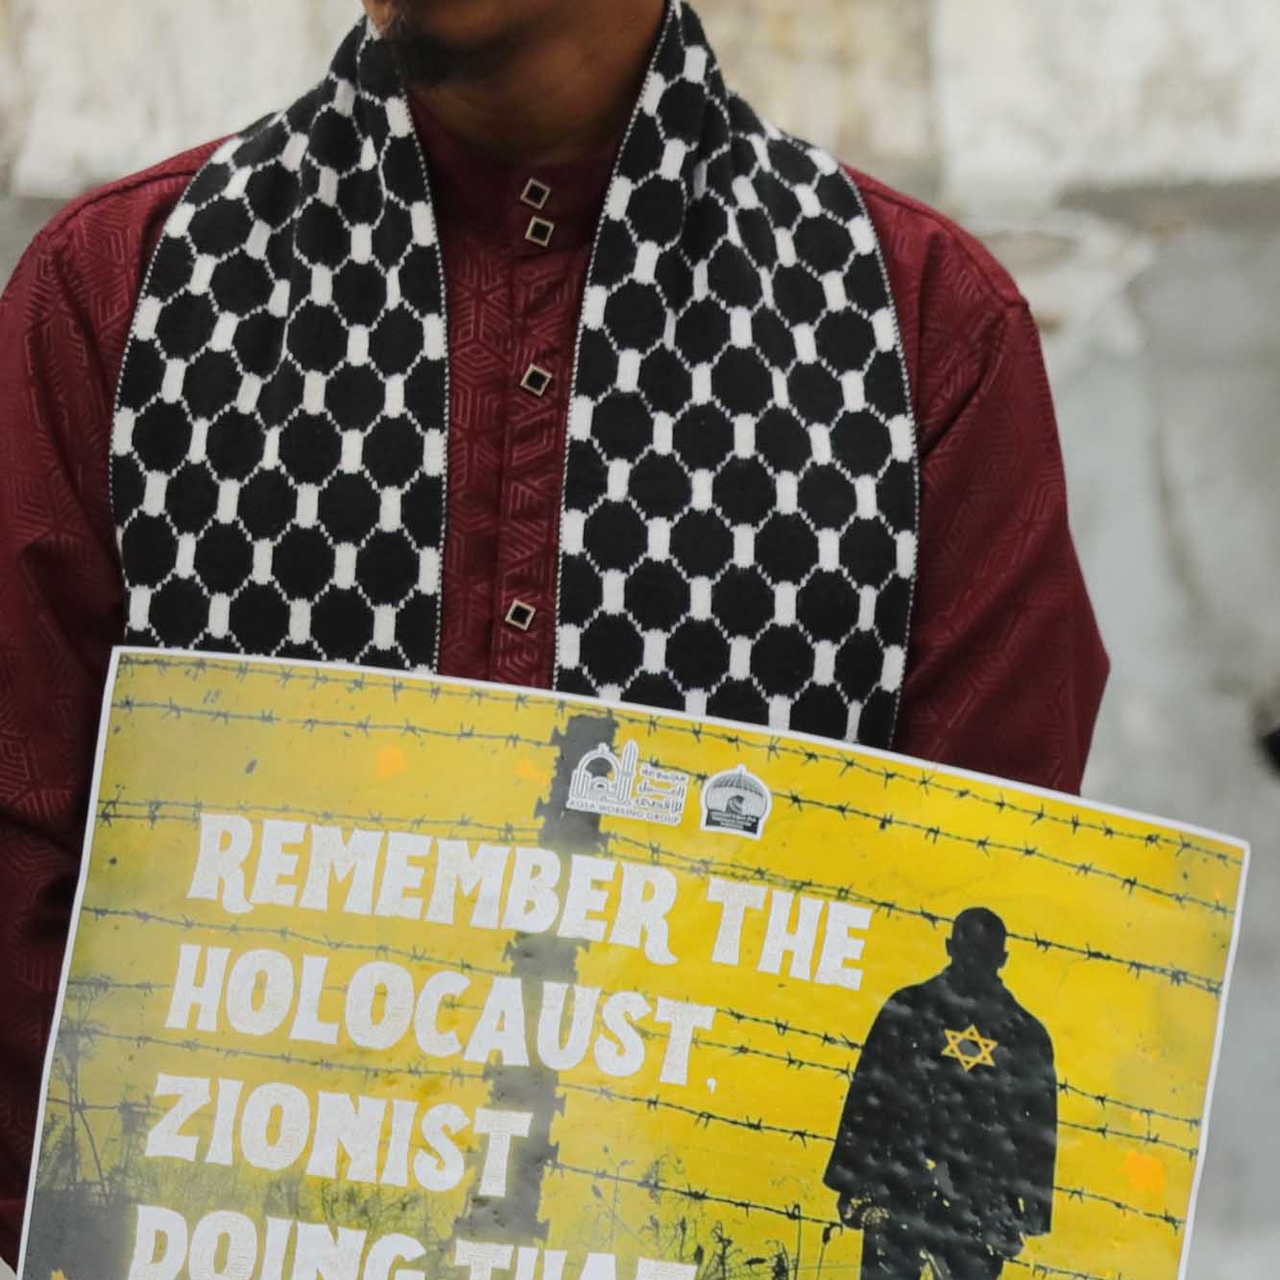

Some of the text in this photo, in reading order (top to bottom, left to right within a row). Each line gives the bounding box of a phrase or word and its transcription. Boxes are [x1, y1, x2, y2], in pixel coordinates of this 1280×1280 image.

[599, 804, 645, 819] WORKING
[646, 811, 681, 825] GROUP
[187, 812, 873, 990] REMEMBER THE
[164, 943, 719, 1094] HOLOCAUST,
[143, 1072, 535, 1199] ZIONIST
